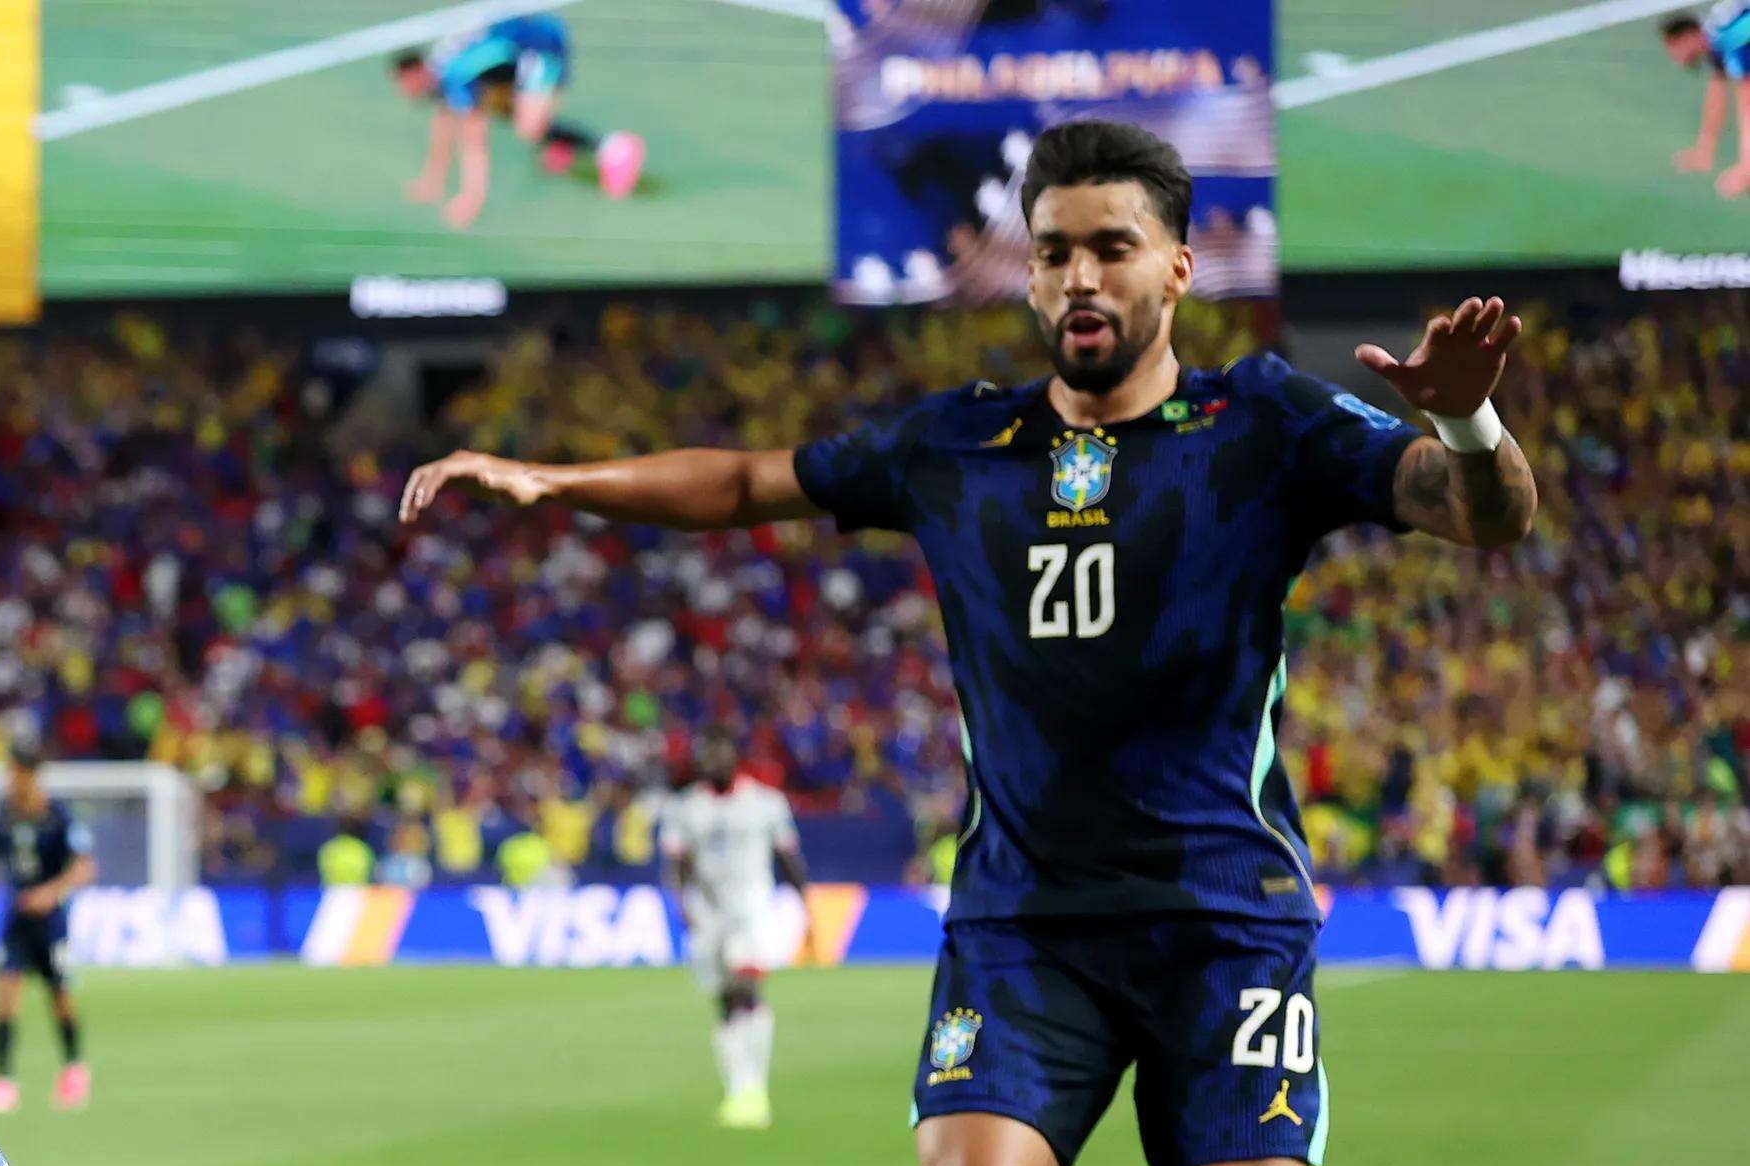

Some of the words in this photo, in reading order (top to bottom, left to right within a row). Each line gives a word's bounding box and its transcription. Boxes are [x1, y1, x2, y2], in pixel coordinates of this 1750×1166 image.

[1046, 508, 1111, 528] BRASIL
[1028, 543, 1116, 638] 20
[468, 884, 674, 967] VISA
[1391, 886, 1606, 970] VISA
[1231, 987, 1315, 1074] 20
